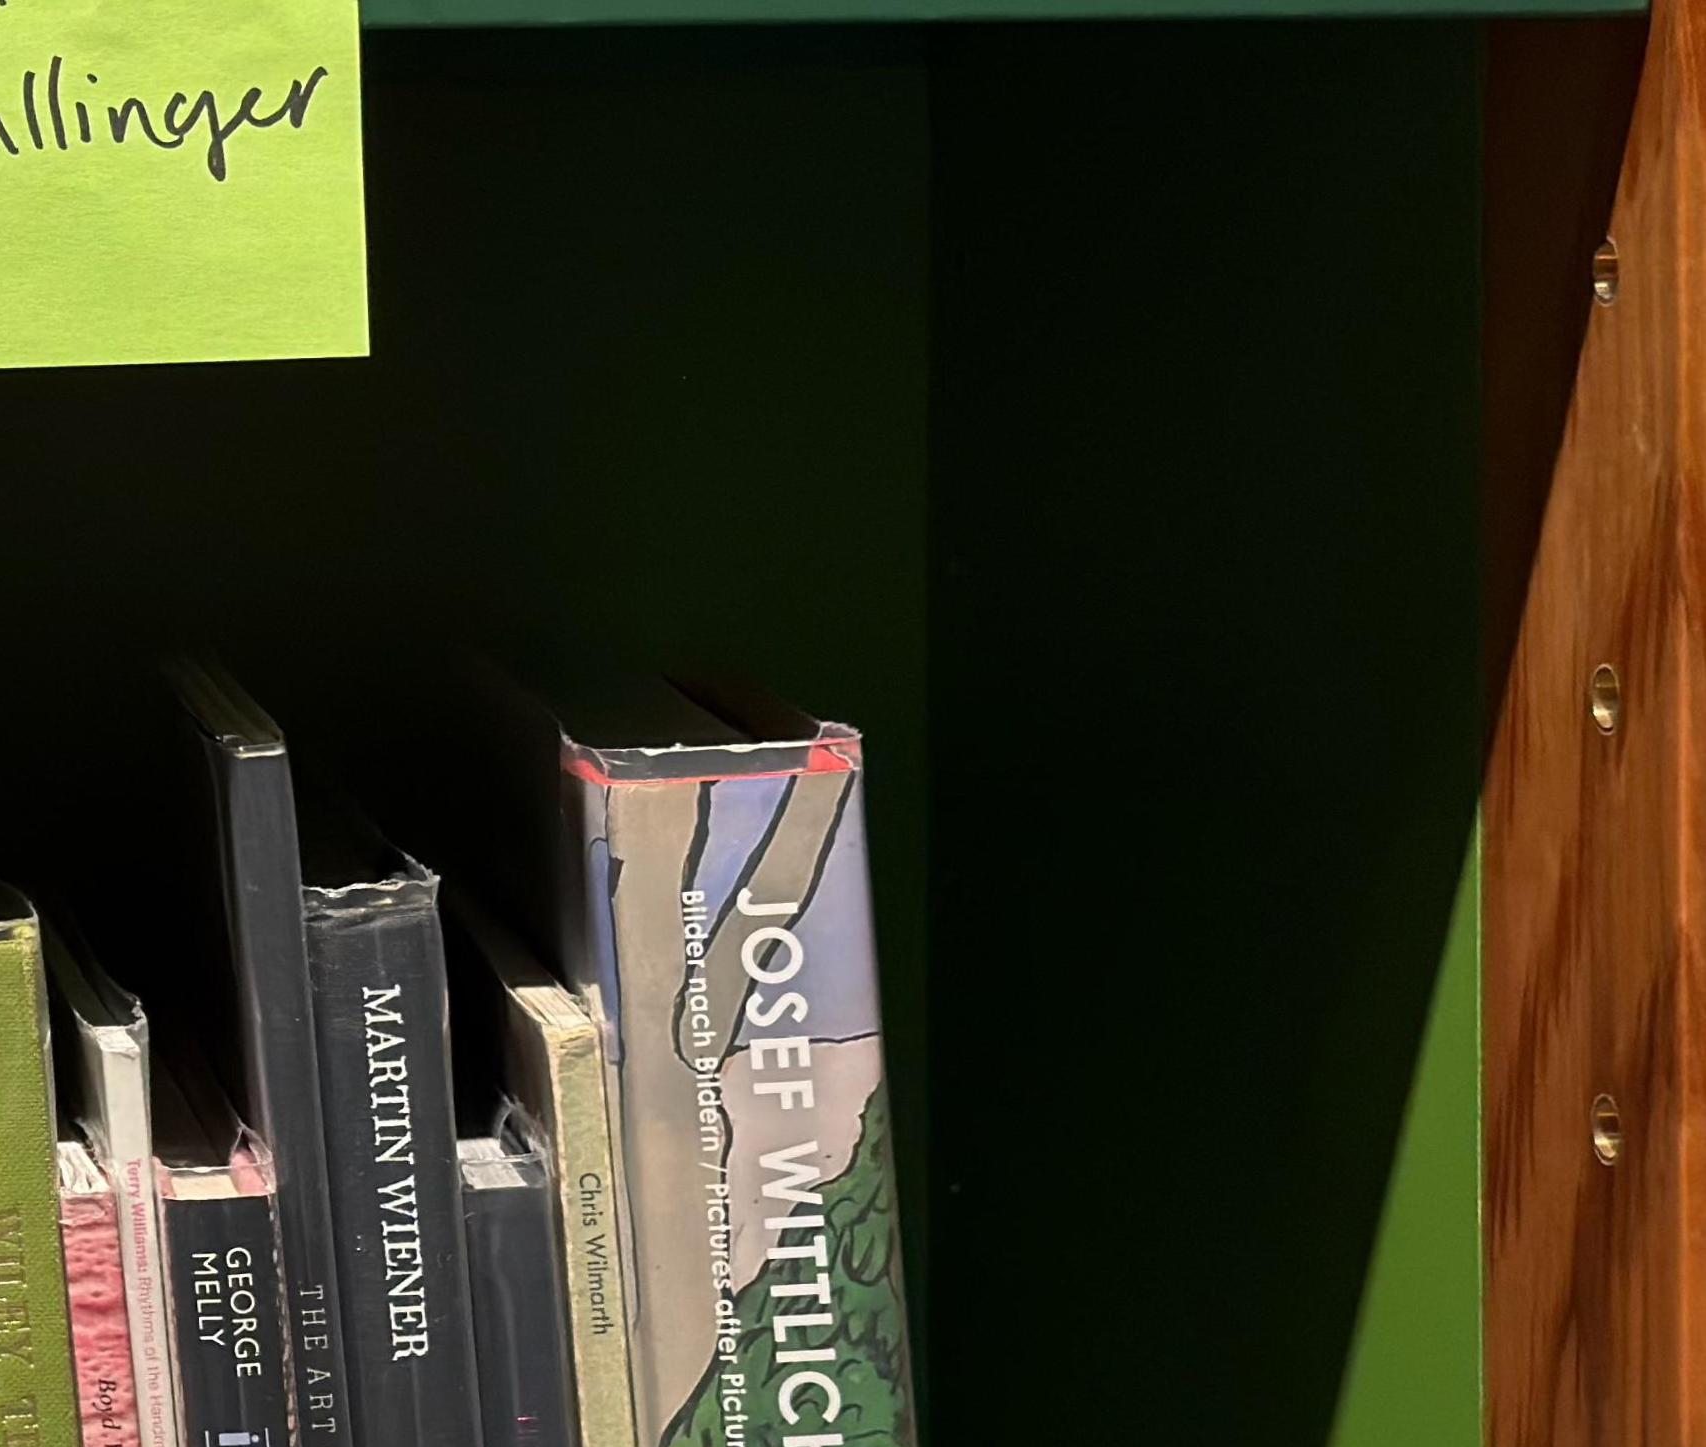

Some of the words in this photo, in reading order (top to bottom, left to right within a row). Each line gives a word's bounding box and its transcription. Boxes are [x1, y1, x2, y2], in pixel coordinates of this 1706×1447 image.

[681, 890, 714, 969] Bilder
[687, 977, 717, 1047] nach
[736, 887, 816, 1110] JOSEF
[362, 984, 412, 1165] MARTIN
[694, 1055, 727, 1153] Bildern
[577, 1174, 604, 1227] Chris
[704, 1181, 738, 1292] Pictures
[135, 1277, 158, 1344] Rhythms
[192, 1252, 224, 1348] MELLY
[374, 1173, 429, 1361] WIENER
[586, 1233, 613, 1336] Wilmarth
[226, 1247, 261, 1378] GEORGE
[300, 1284, 331, 1351] THE
[714, 1300, 743, 1364] after
[93, 1379, 122, 1430] Boyd
[307, 1367, 338, 1433] ART
